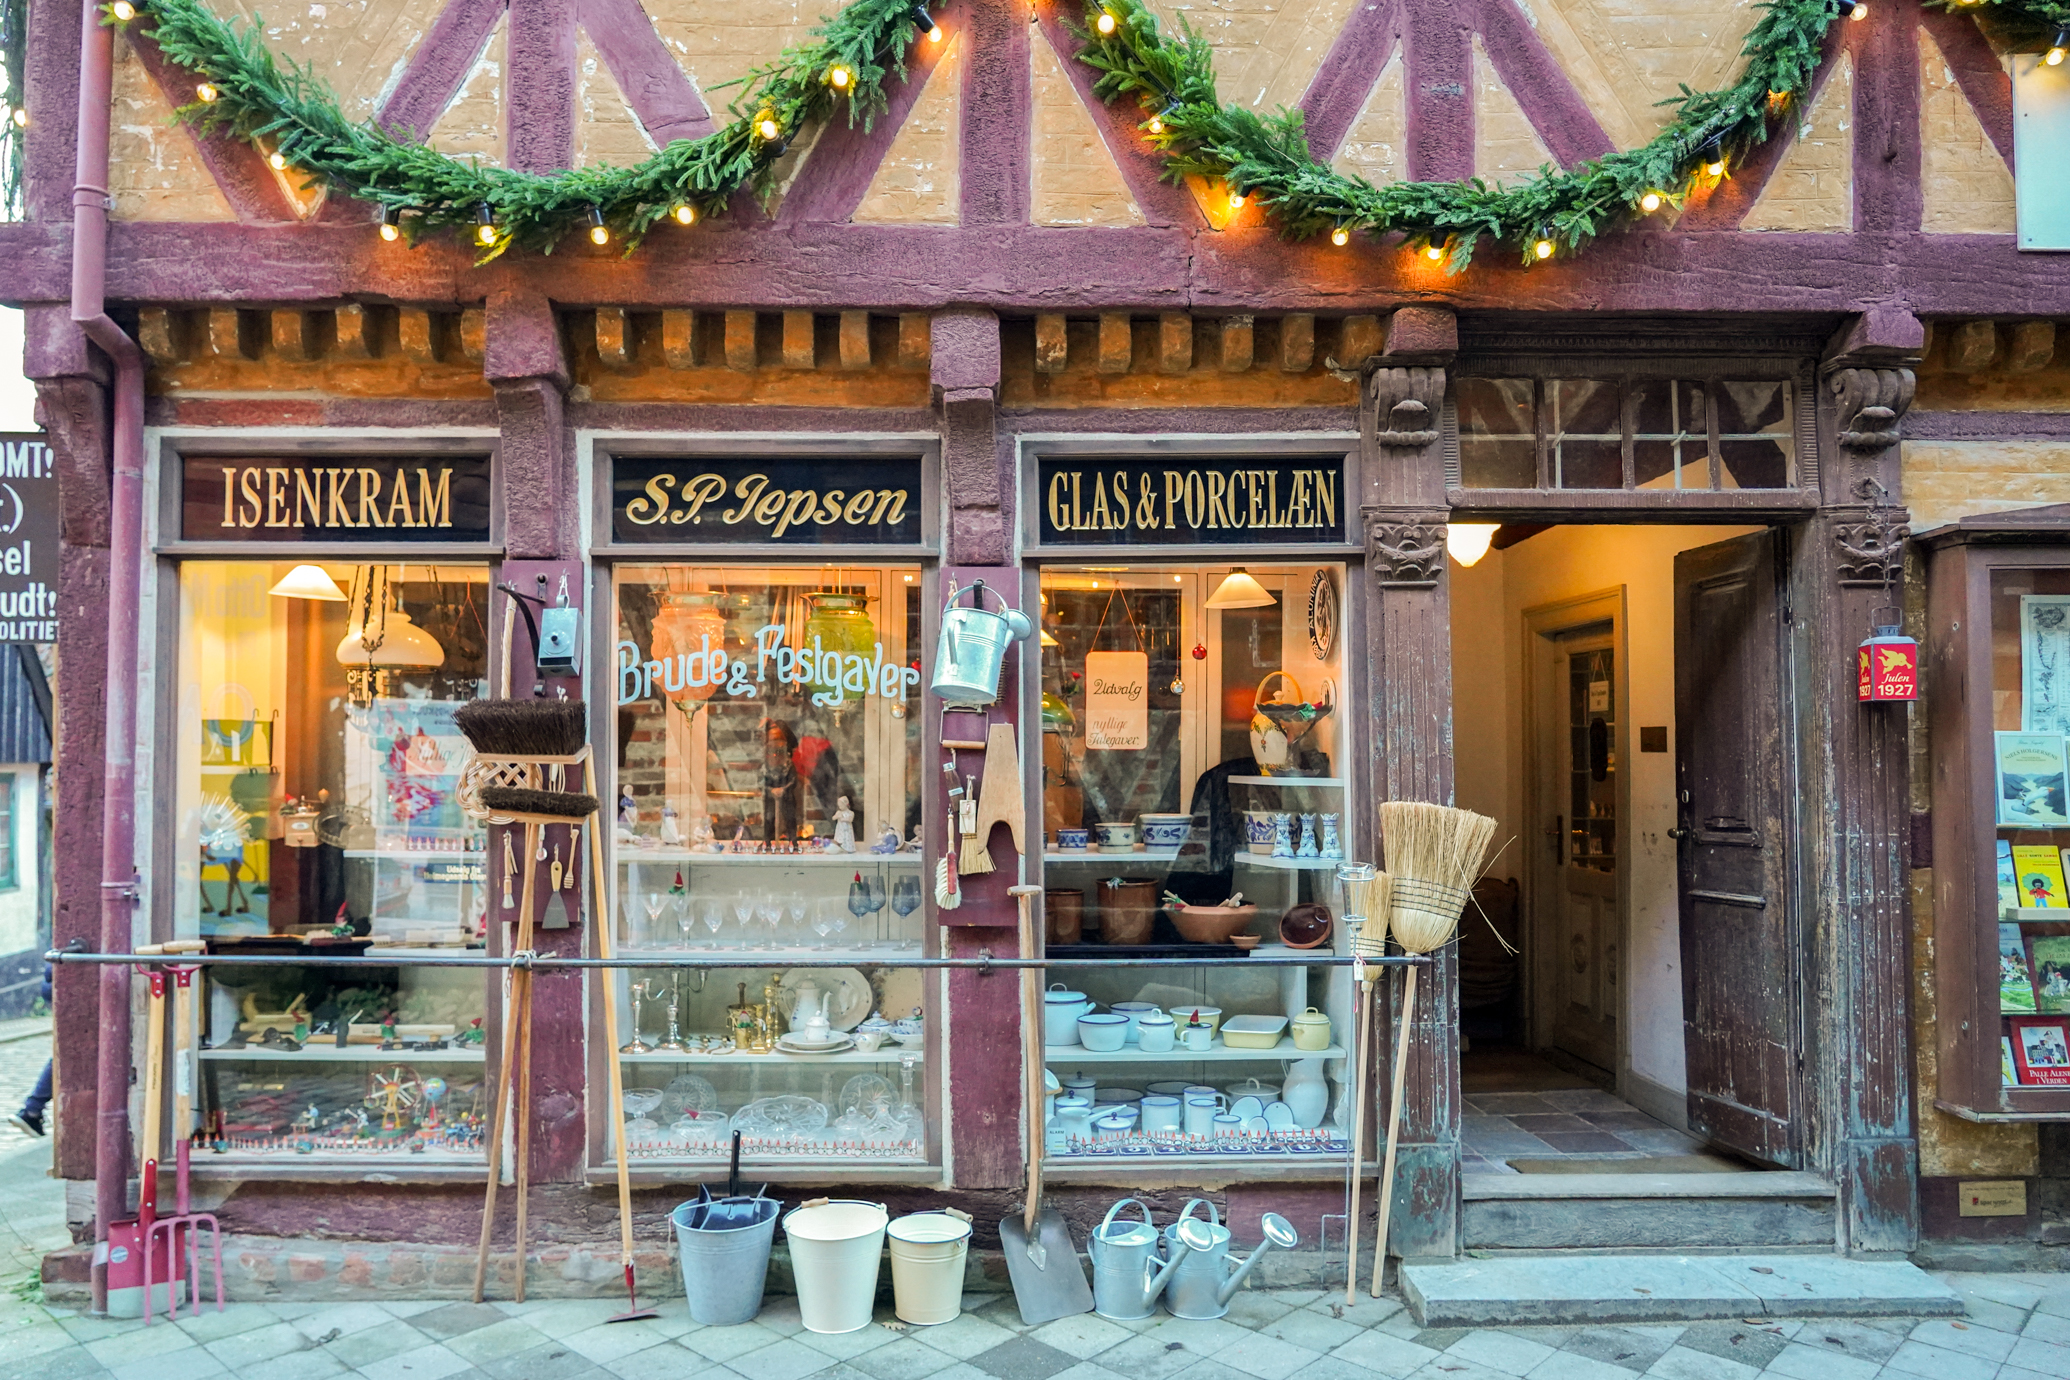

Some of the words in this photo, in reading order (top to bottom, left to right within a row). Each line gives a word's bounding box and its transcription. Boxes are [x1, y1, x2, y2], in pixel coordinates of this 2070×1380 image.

[221, 467, 453, 528] ISENKRAM
[722, 473, 908, 538] Jepsen
[1048, 470, 1131, 532] GLAS
[1135, 472, 1160, 530] &
[1163, 469, 1337, 530] PORCELÆN
[617, 634, 728, 706] Brude
[755, 624, 920, 708] Festgaver
[1878, 684, 1914, 696] 1927
[1881, 672, 1910, 684] Julen
[2029, 1069, 2049, 1078] PALLE
